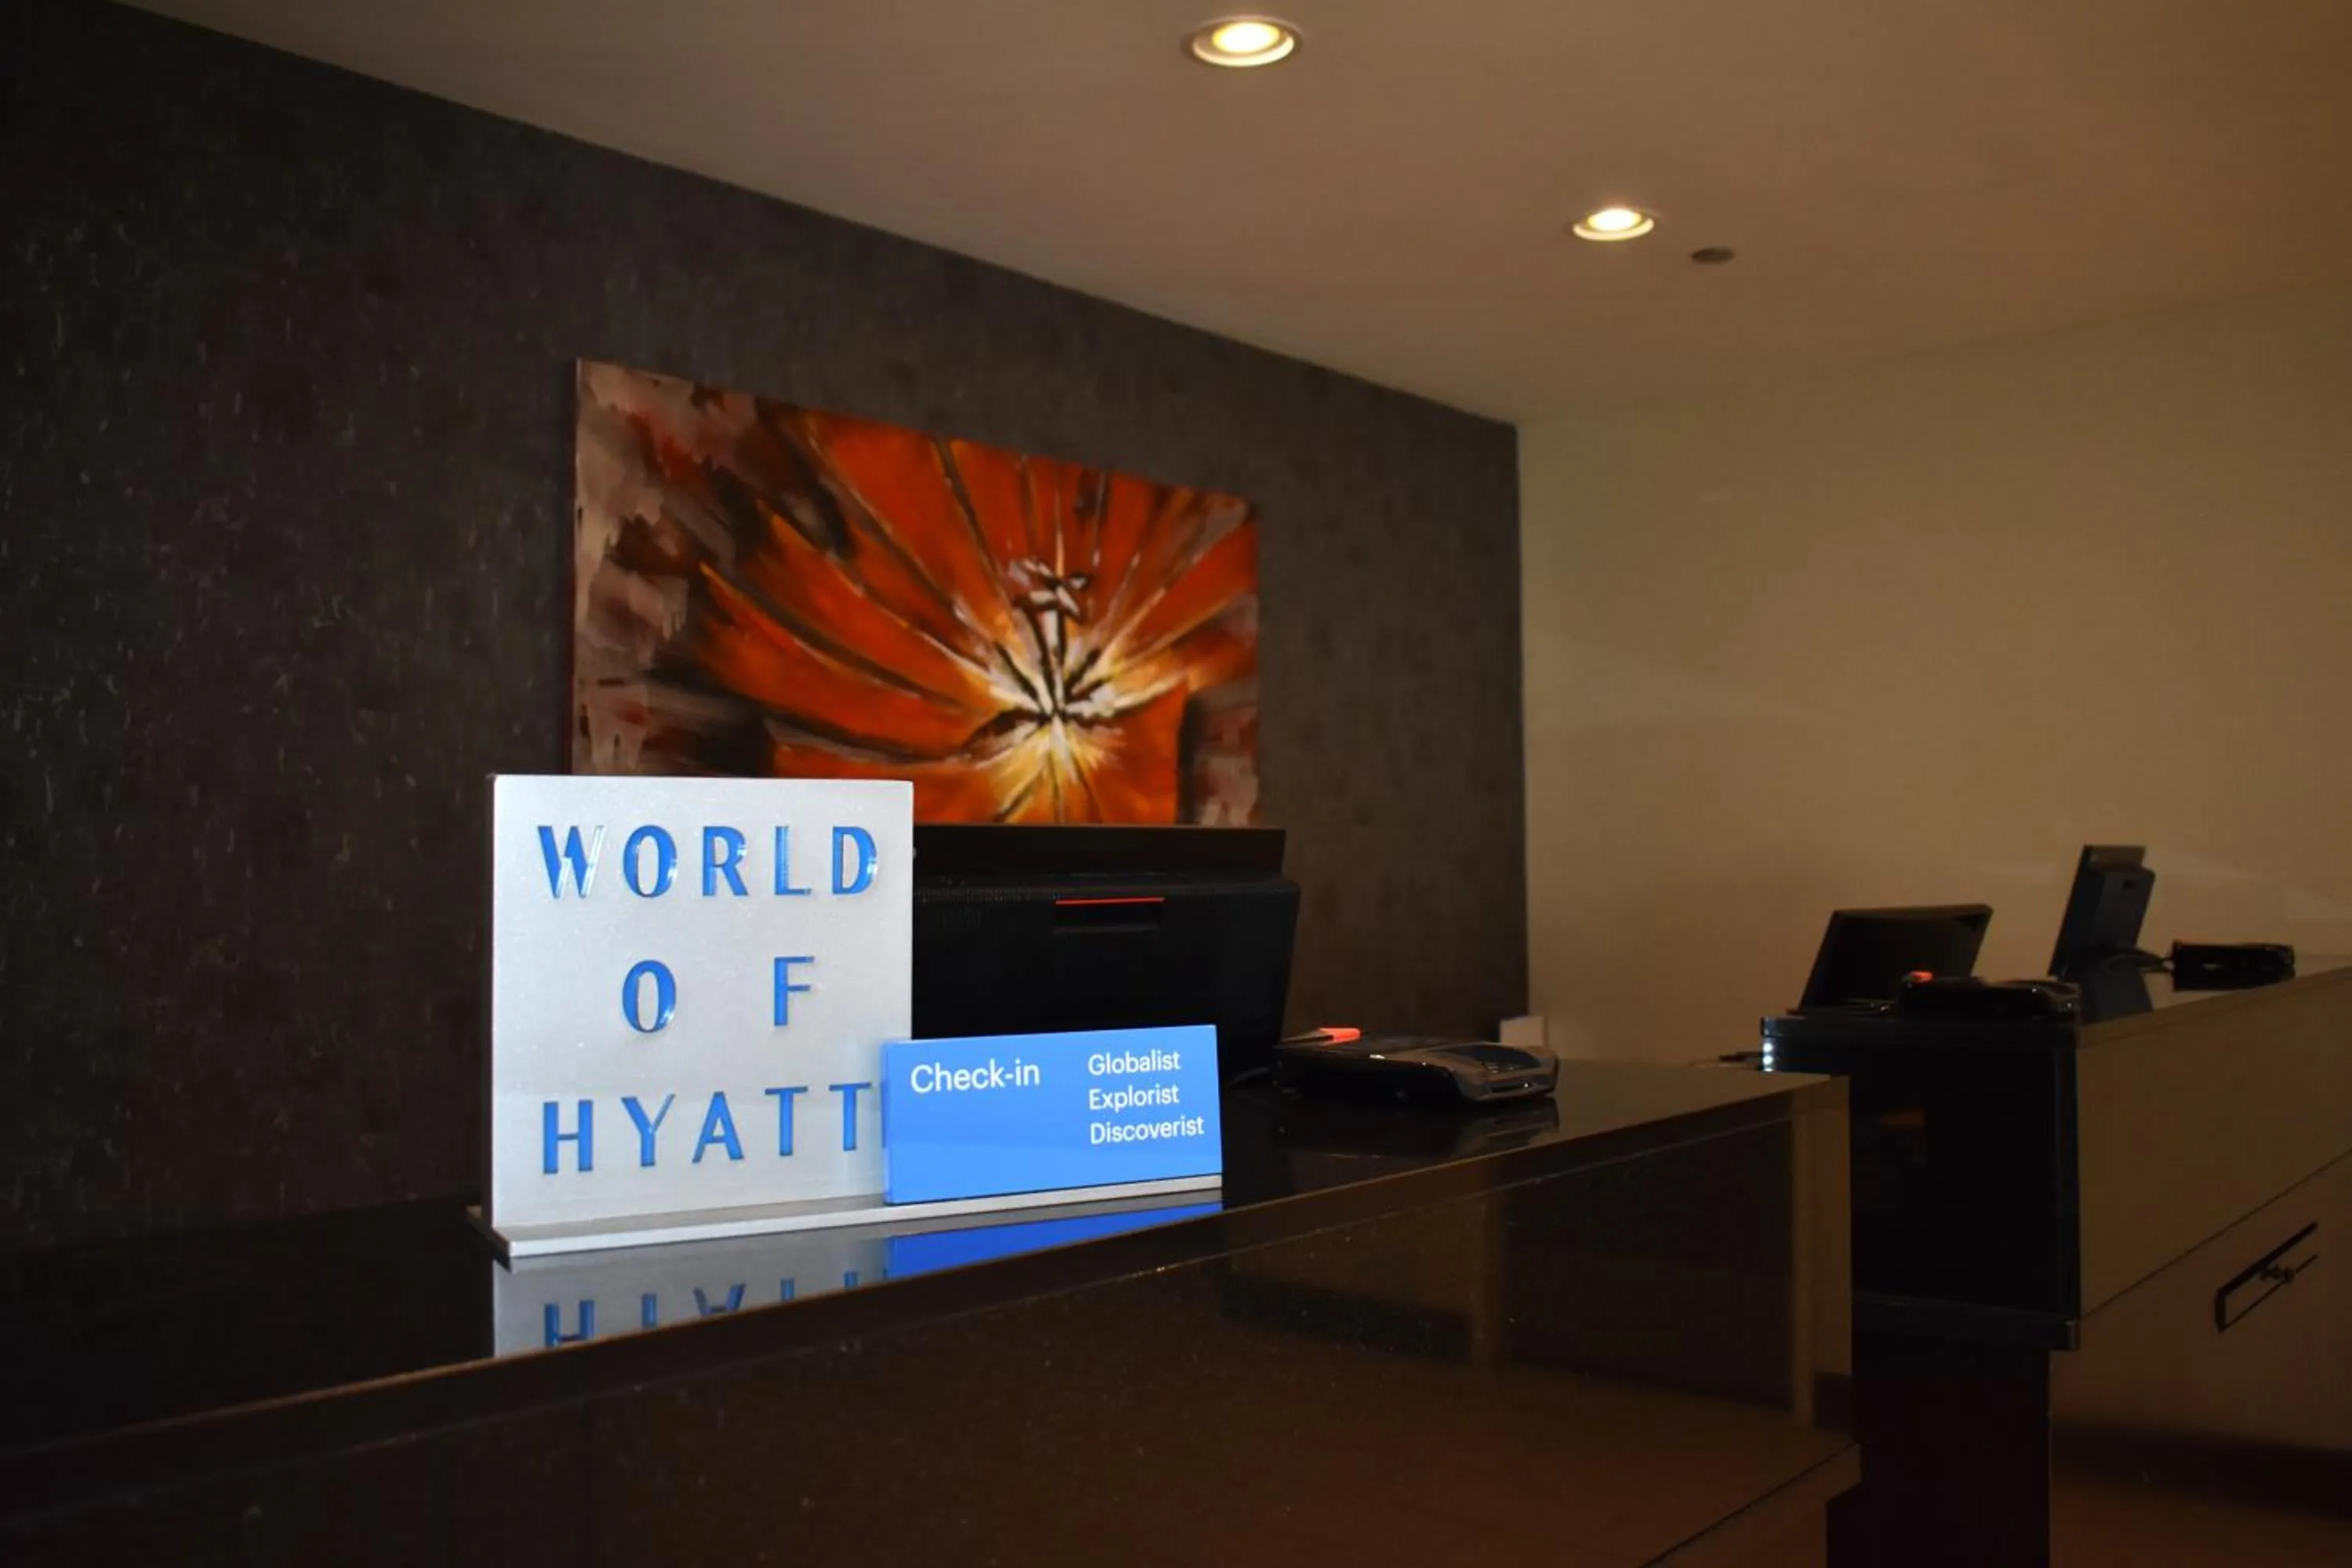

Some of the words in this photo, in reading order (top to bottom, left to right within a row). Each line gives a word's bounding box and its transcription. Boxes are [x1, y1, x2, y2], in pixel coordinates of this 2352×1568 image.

[536, 824, 878, 899] WORLD
[621, 956, 815, 1034] OF
[910, 1058, 1040, 1094] Check-in
[1087, 1049, 1181, 1076] Globalist
[1088, 1083, 1180, 1112] Explorist
[542, 1081, 872, 1175] HYATT
[1091, 1116, 1205, 1145] Discoverist
